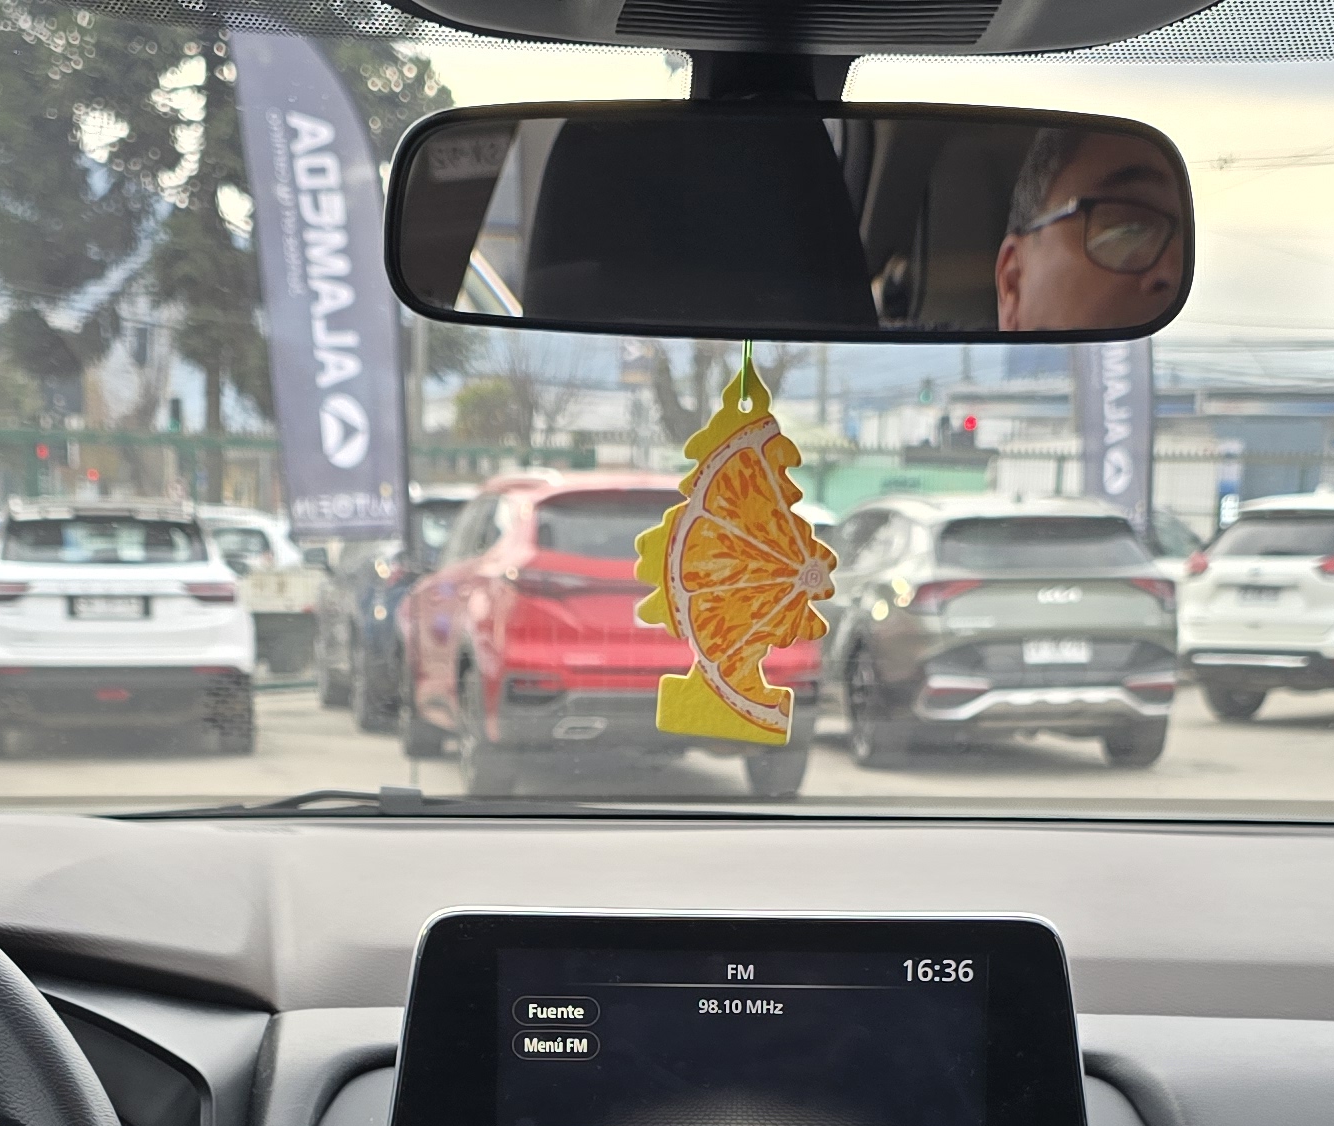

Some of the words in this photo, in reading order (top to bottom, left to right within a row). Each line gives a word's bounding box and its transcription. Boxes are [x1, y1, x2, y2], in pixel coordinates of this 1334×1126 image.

[727, 964, 755, 980] FM
[902, 959, 974, 982] 16:36
[528, 1003, 585, 1020] Fuente
[698, 999, 742, 1014] 98.10
[746, 1000, 784, 1014] MHz
[524, 1037, 563, 1053] Menú
[566, 1038, 588, 1053] FM
